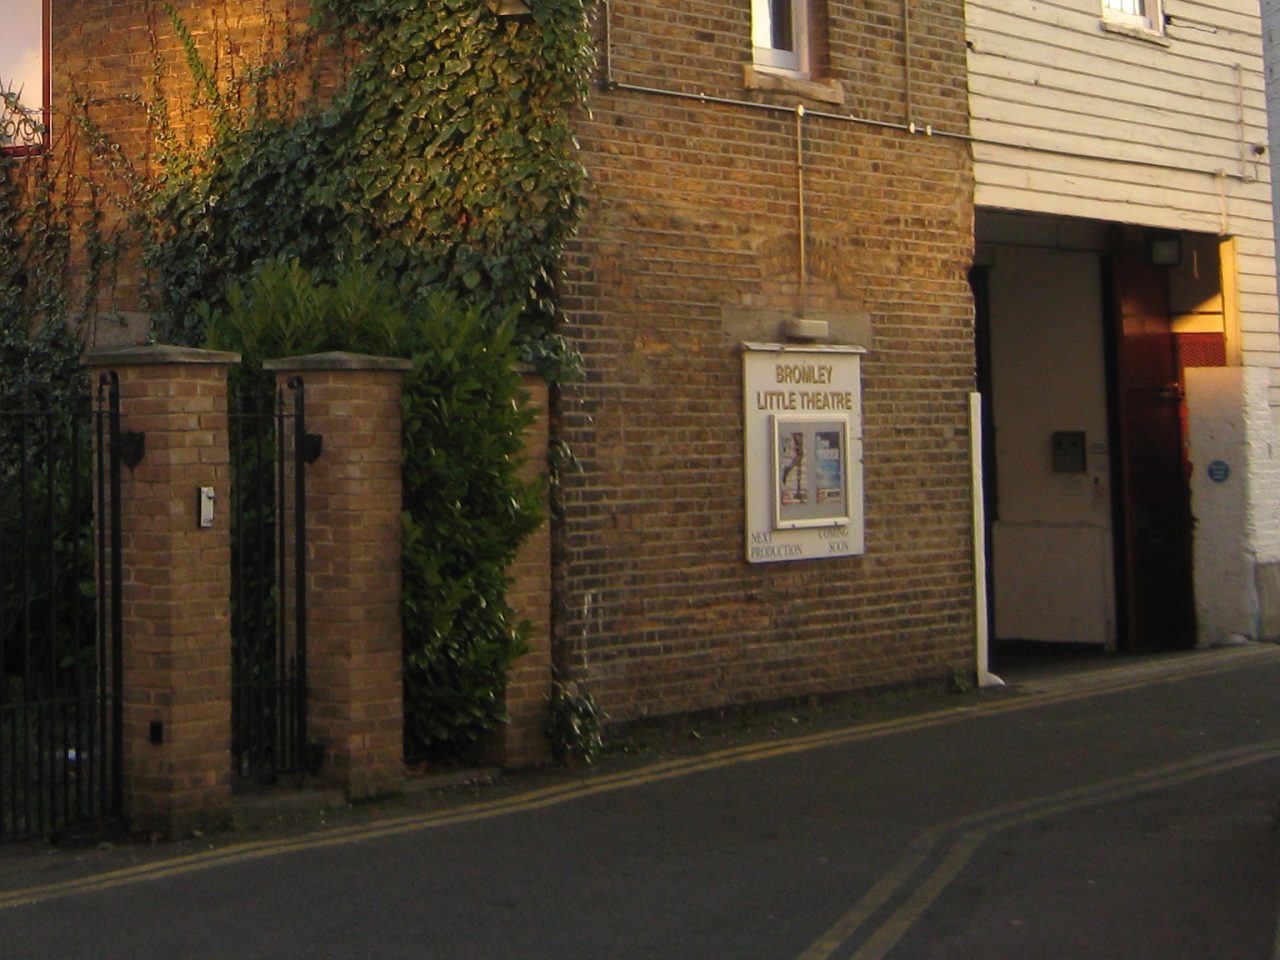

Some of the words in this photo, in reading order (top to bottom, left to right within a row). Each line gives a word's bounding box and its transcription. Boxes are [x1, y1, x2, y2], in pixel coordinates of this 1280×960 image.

[775, 363, 833, 384] BROMLEY
[756, 391, 797, 411] LITTLE
[798, 390, 853, 411] THEATRE
[751, 531, 772, 544] NEXT
[751, 543, 802, 559] PRODUCTION
[829, 540, 849, 552] SOON
